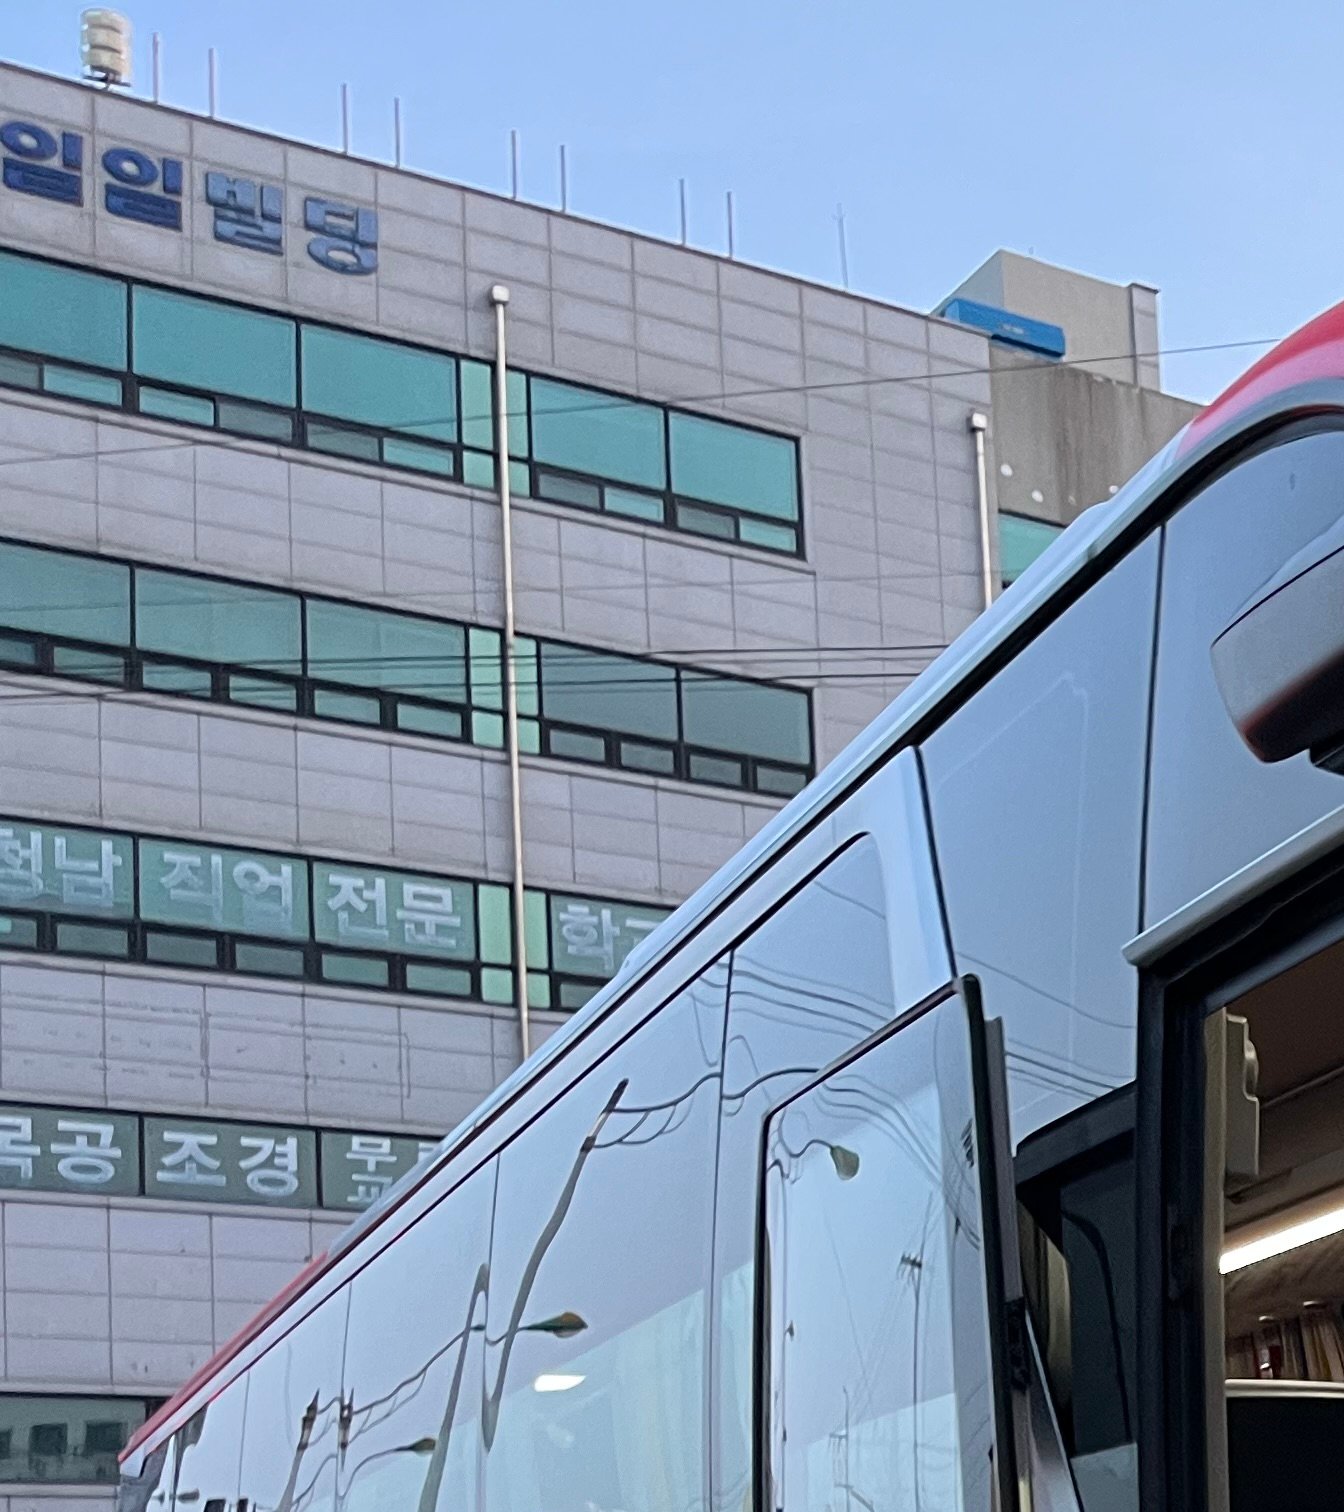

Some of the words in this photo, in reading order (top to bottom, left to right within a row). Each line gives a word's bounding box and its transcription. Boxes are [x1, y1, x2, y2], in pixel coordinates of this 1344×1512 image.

[0, 120, 379, 276] 일일빌딩
[160, 853, 293, 936] 직업
[327, 874, 461, 950] 전문
[156, 1131, 300, 1197] 조경
